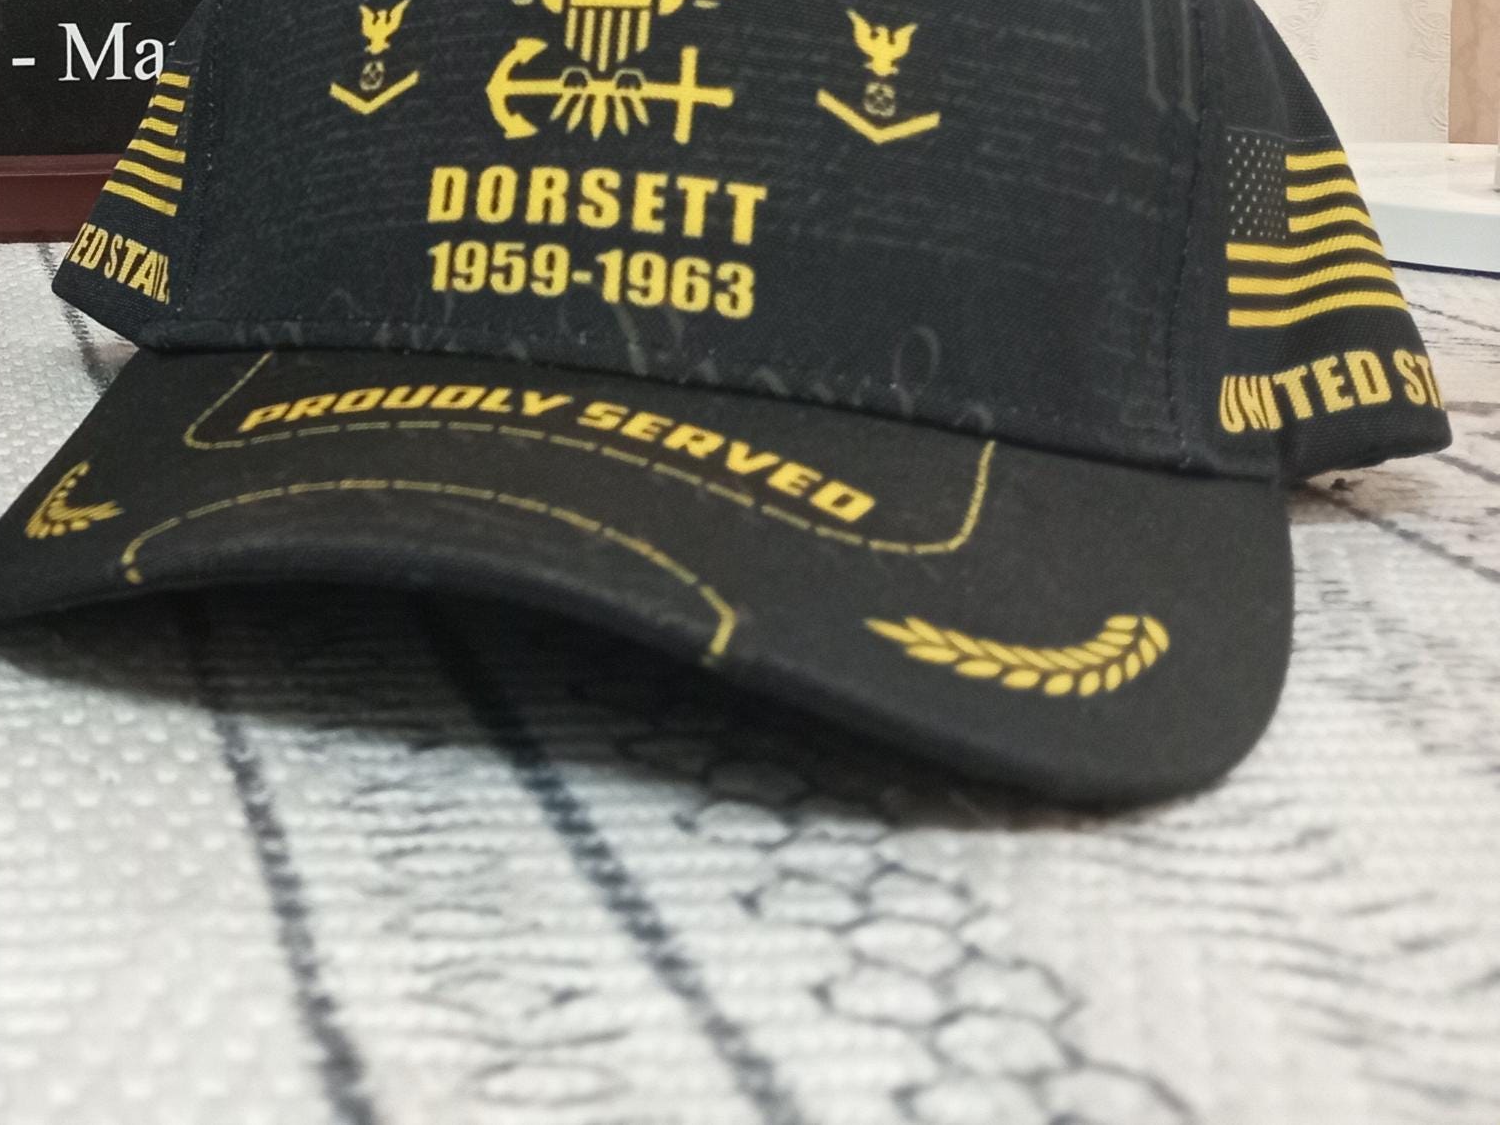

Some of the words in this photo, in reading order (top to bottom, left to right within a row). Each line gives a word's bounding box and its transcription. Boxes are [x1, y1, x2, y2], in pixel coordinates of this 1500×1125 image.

[11, 56, 36, 67] -
[58, 22, 177, 82] Ma
[426, 164, 768, 246] DORSETT
[66, 222, 109, 270] ED
[429, 240, 756, 320] 1959-1963
[1219, 349, 1393, 434] UNITED
[237, 384, 572, 433] PROUDLY
[577, 401, 876, 524] SERVED
